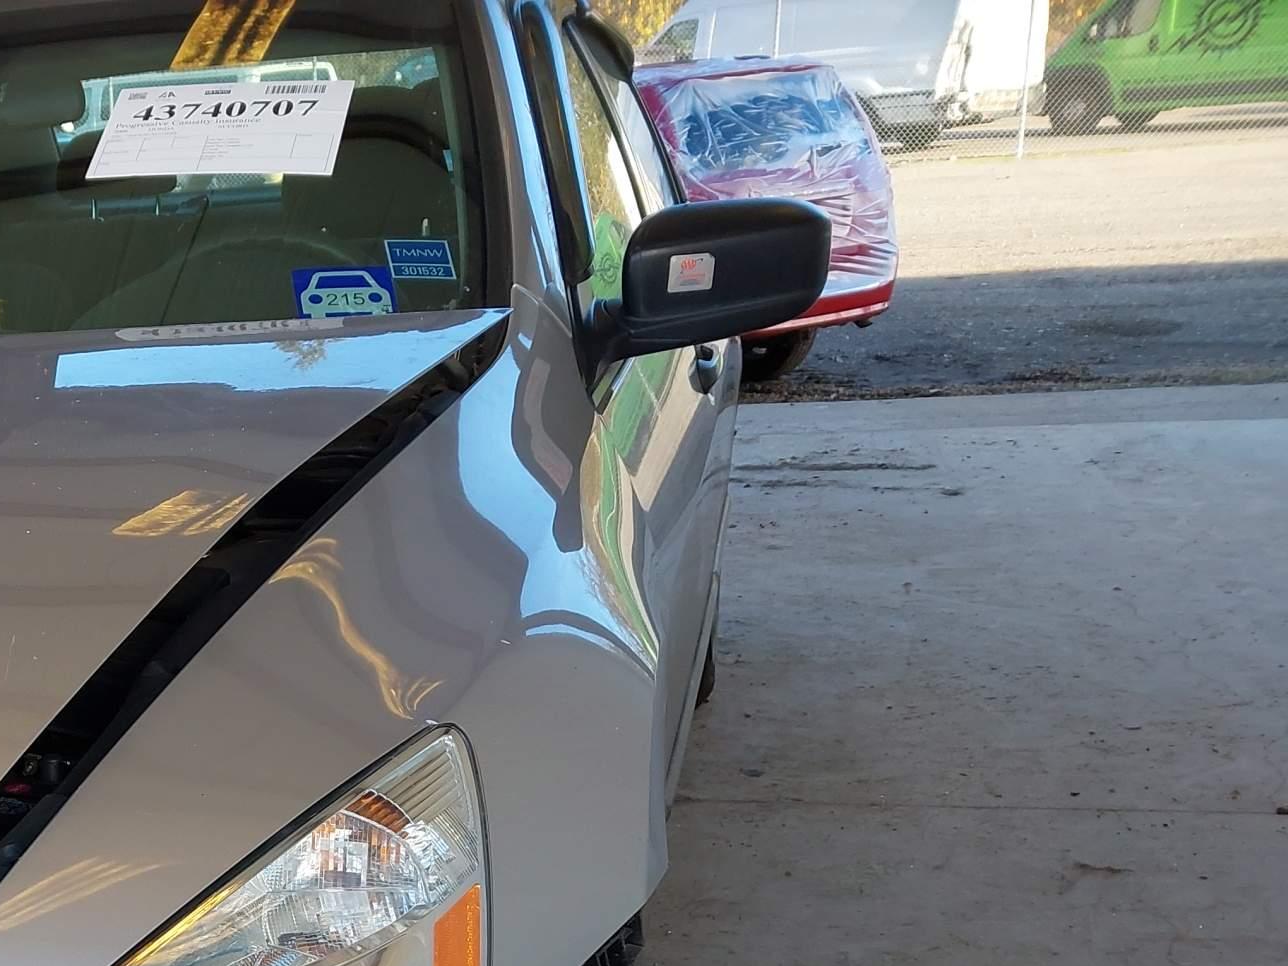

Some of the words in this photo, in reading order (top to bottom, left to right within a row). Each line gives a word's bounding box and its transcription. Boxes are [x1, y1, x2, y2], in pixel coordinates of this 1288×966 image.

[132, 99, 320, 121] 43740707
[393, 247, 443, 258] TMNW
[401, 266, 446, 276] 301532
[326, 292, 366, 306] 215
